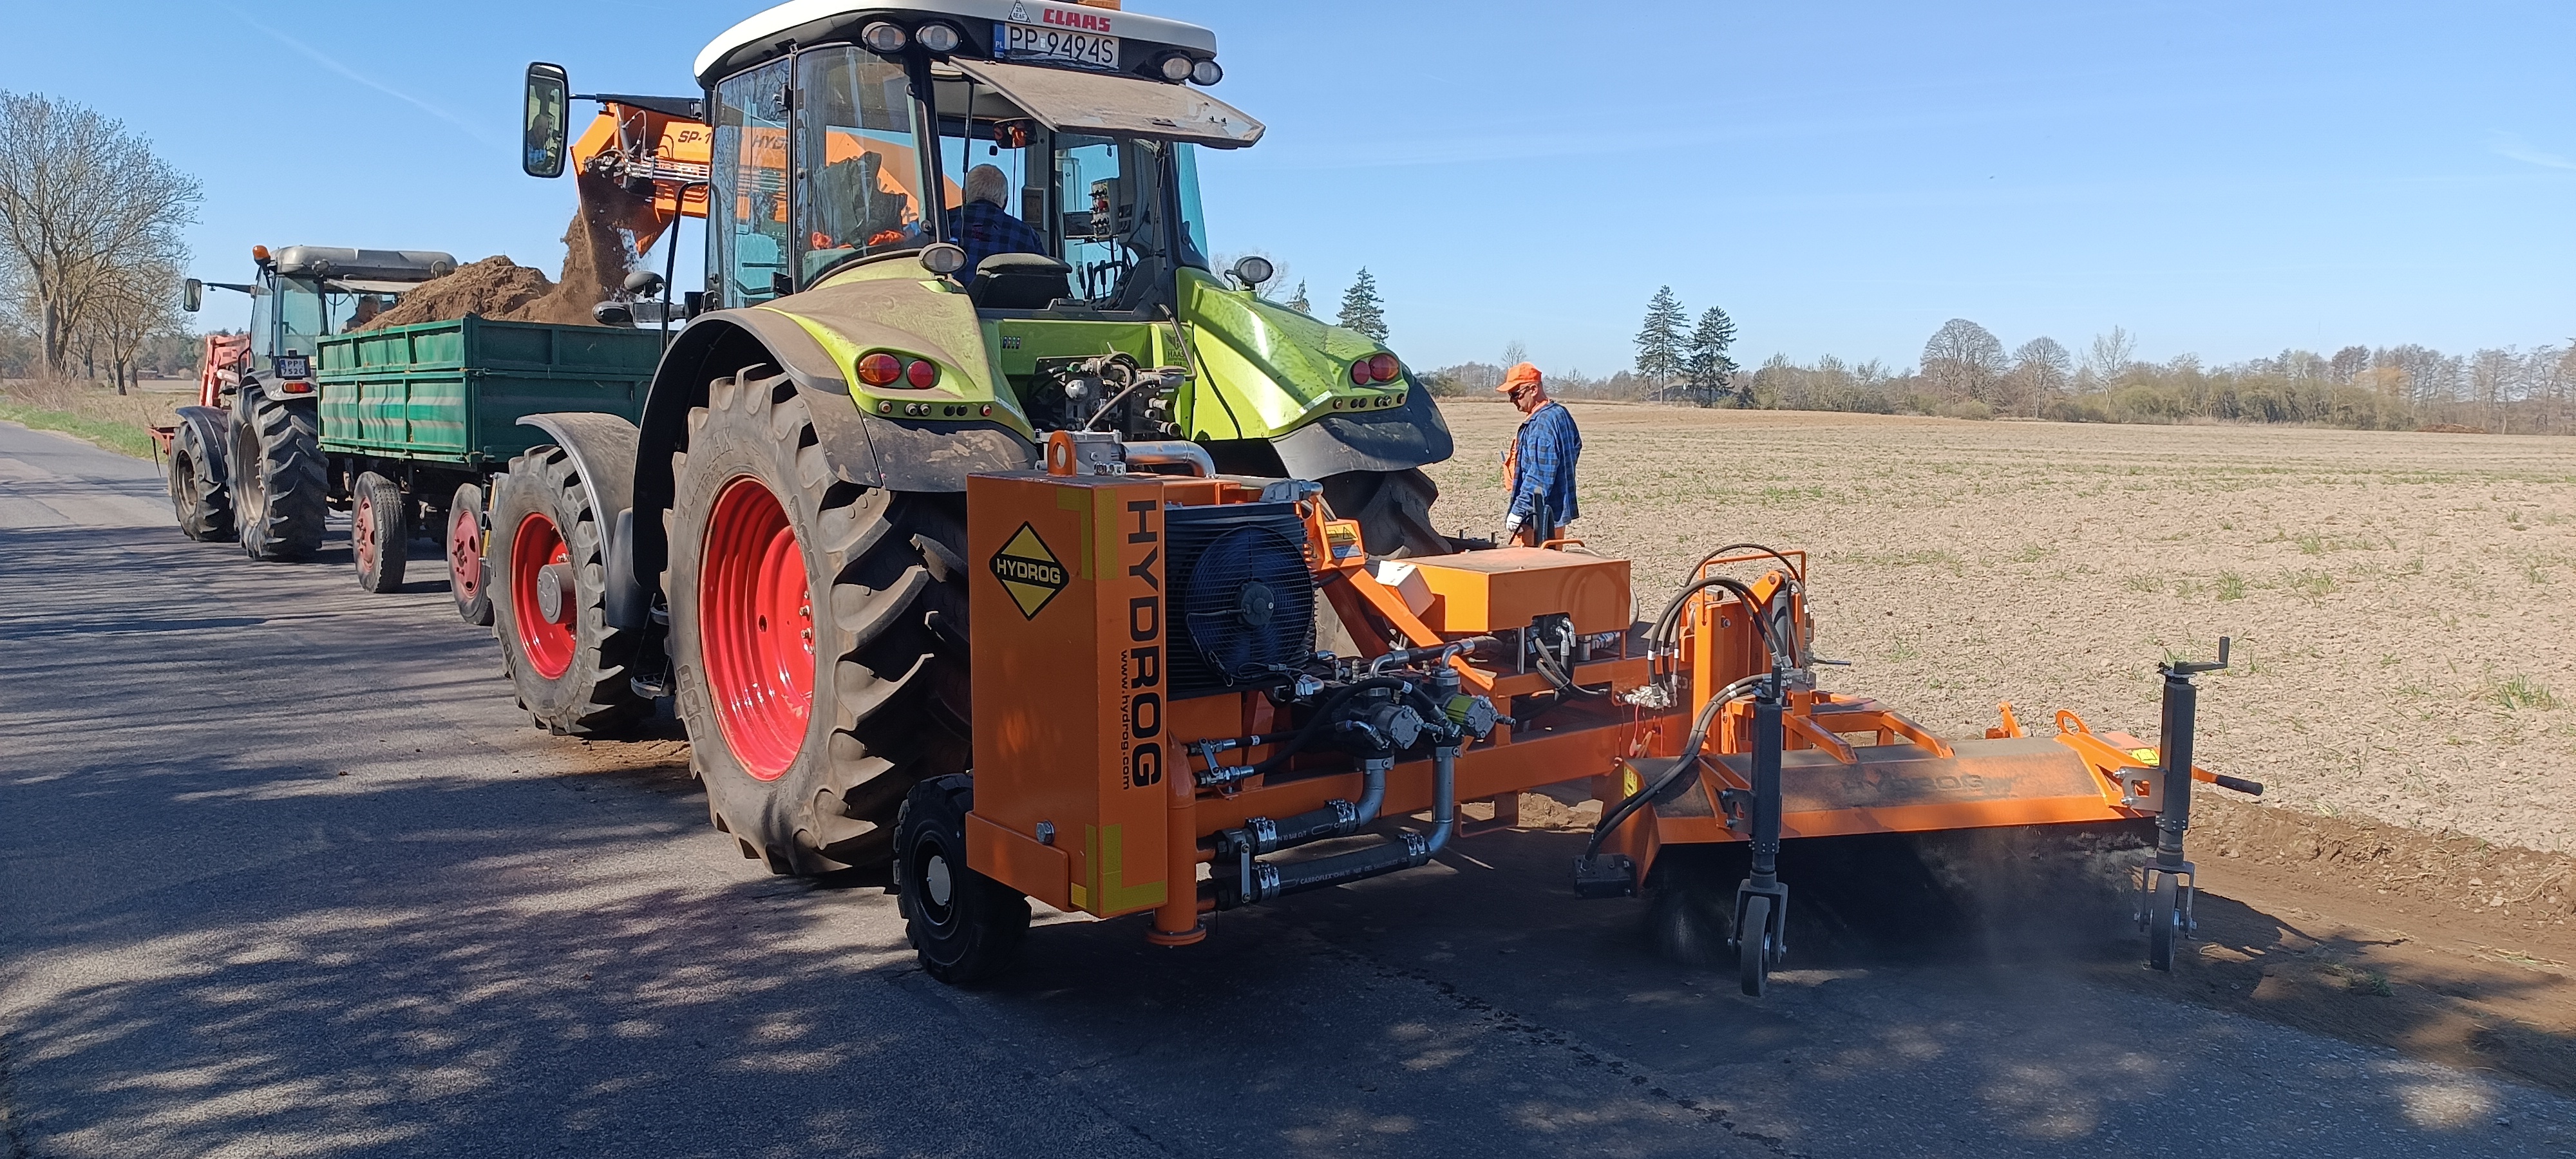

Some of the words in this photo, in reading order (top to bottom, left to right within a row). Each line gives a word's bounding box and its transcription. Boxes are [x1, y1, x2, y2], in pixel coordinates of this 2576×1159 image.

[1043, 8, 1111, 32] CLAAS
[995, 41, 1003, 49] PL
[1010, 26, 1038, 50] PP
[1047, 32, 1113, 63] 9494S
[996, 558, 1061, 584] HYDROG
[1127, 500, 1162, 787] HYDROG
[1120, 649, 1130, 791] www.hydrog.com
